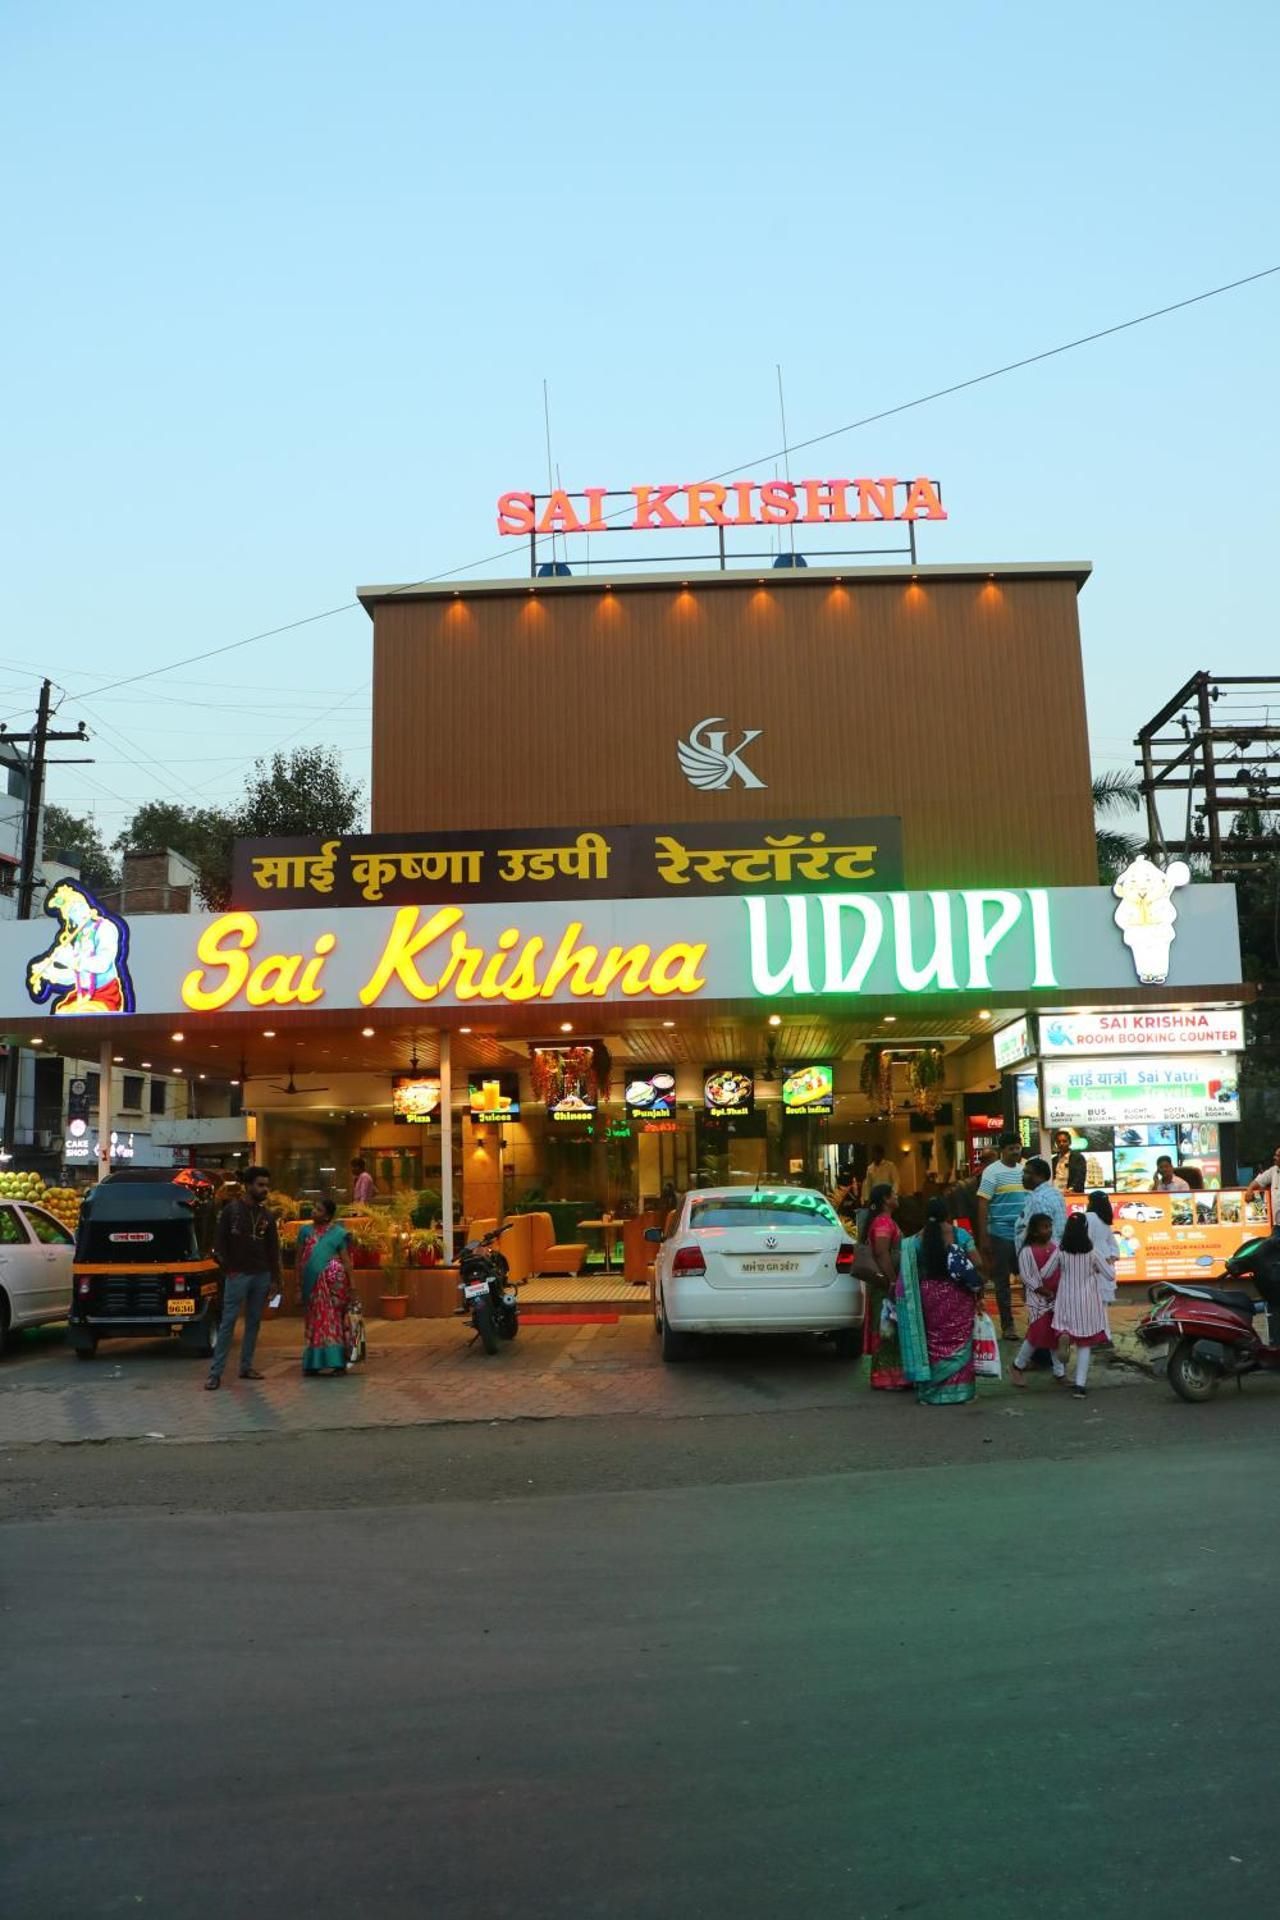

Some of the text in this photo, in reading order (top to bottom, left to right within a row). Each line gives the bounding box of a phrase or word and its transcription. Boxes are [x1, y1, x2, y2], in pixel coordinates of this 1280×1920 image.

[497, 478, 948, 535] SAI KRISHNA
[252, 832, 878, 901] साई कृष्णा उडपी रेस्टॉरंट
[181, 889, 1059, 1011] Sai Krishna UDUPI
[1099, 1015, 1209, 1029] SAI KRISHNA
[1077, 1030, 1237, 1044] ROOM BOOKING COUNTER
[1138, 1068, 1200, 1083] Sai Yatri
[1087, 1108, 1107, 1116] BUS
[65, 1140, 89, 1148] CAKE
[65, 1149, 89, 1157] SHOP
